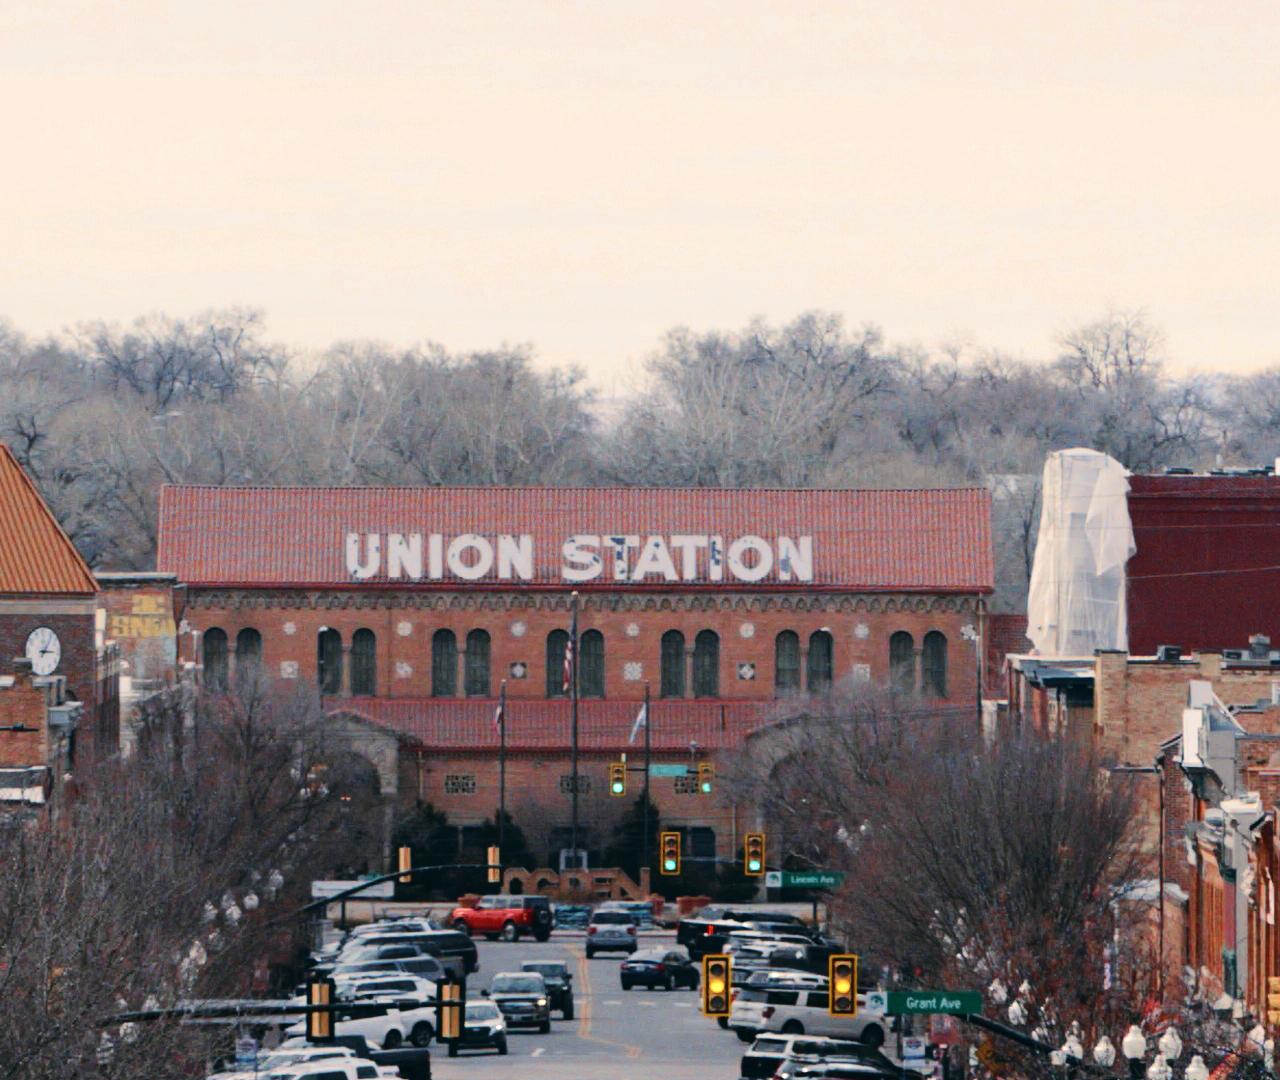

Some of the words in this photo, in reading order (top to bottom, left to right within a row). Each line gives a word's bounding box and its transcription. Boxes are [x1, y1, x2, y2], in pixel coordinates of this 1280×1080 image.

[346, 532, 533, 580] UNION
[562, 534, 813, 581] STATION
[790, 875, 818, 884] Lincoln
[820, 875, 835, 884] Ave
[906, 997, 937, 1009] Grant
[940, 997, 962, 1009] Ave
